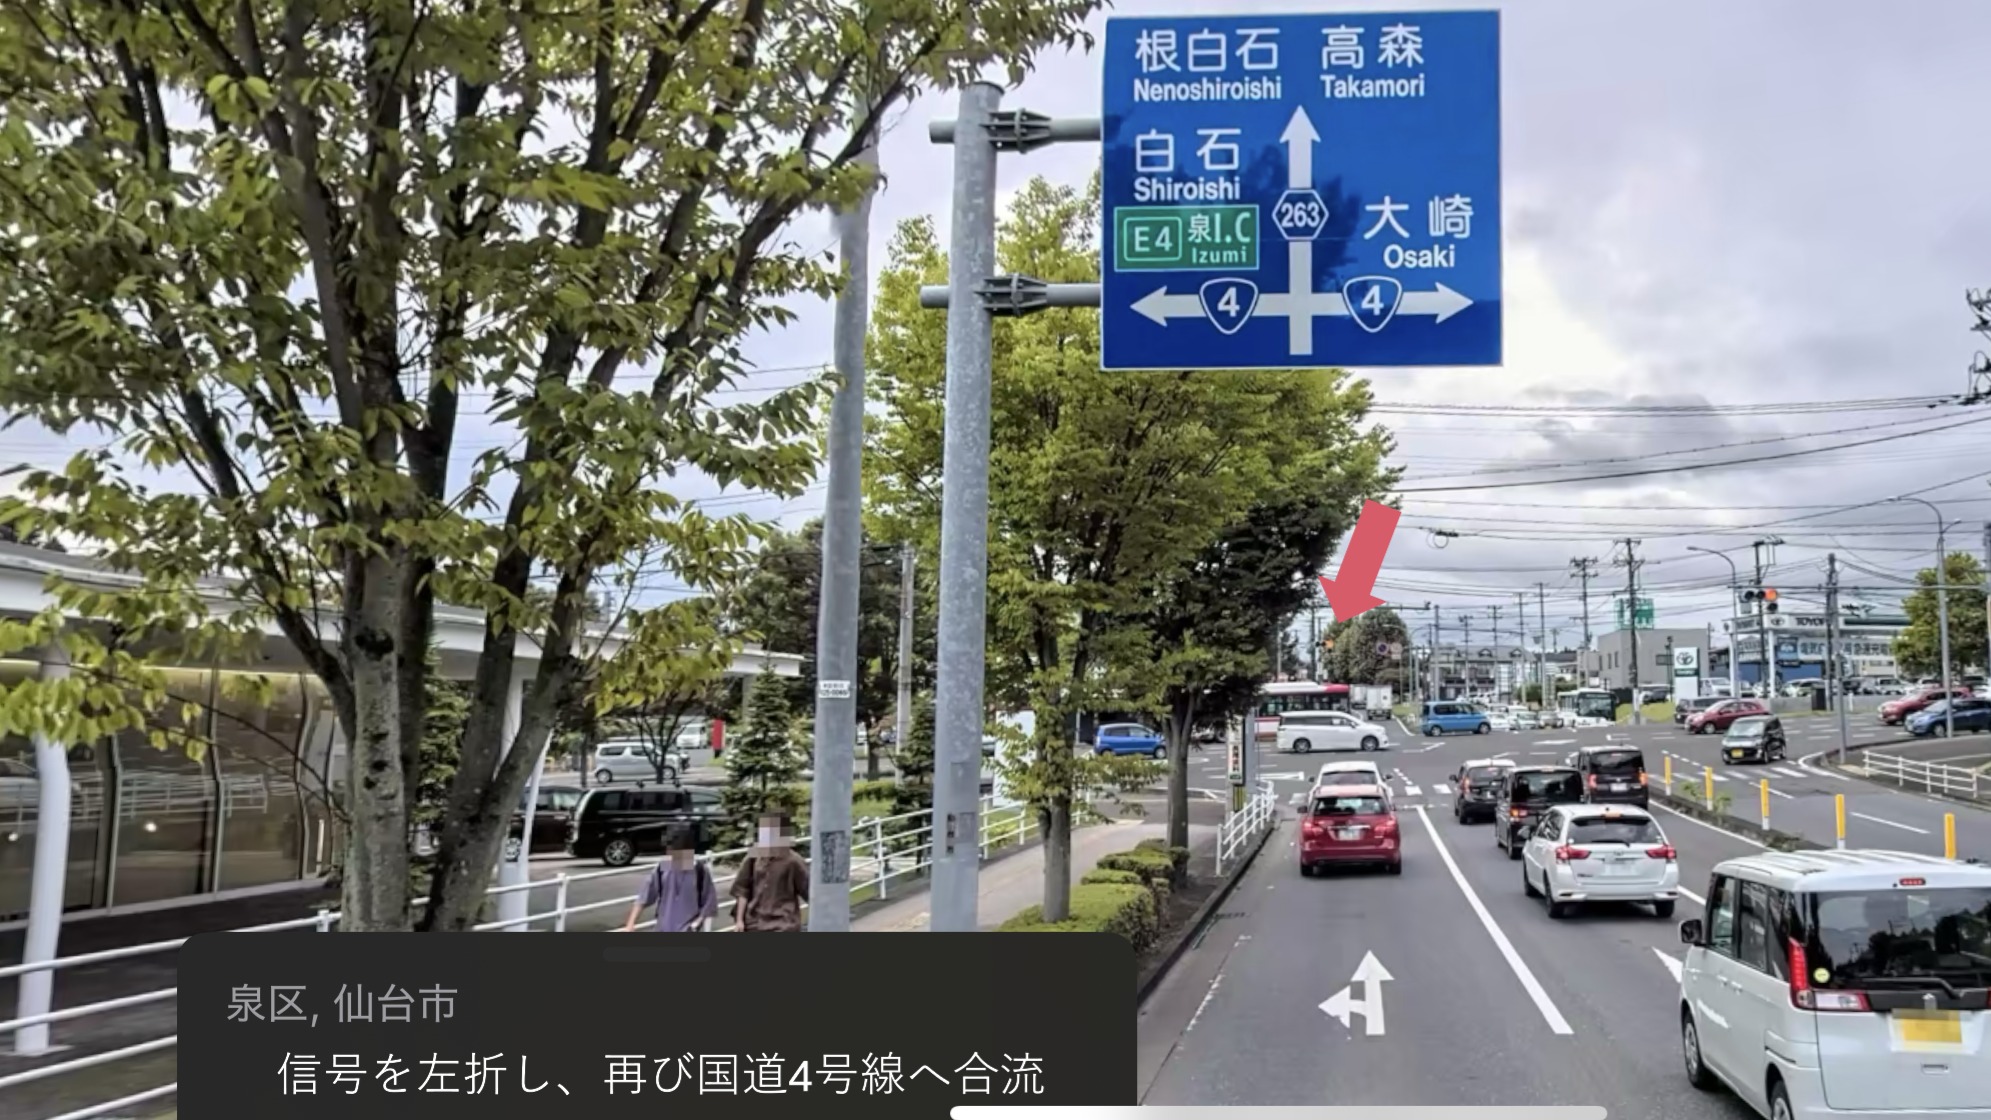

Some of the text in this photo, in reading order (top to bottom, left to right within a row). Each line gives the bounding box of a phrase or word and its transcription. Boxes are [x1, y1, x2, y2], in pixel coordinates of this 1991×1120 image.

[1135, 28, 1280, 73] 根白石
[1320, 24, 1424, 70] 高森
[1134, 77, 1282, 102] Nenoshiroishi
[1321, 74, 1425, 98] Takamori
[1135, 128, 1241, 173] 白石
[1134, 177, 1240, 202] Shiroishi
[1280, 202, 1320, 228] 263
[1364, 194, 1474, 240] 大崎
[1134, 226, 1174, 252] E4
[1191, 247, 1248, 264] Izumi
[1383, 244, 1456, 269] Osaki
[1217, 287, 1241, 317] 4
[1360, 285, 1385, 315] 4
